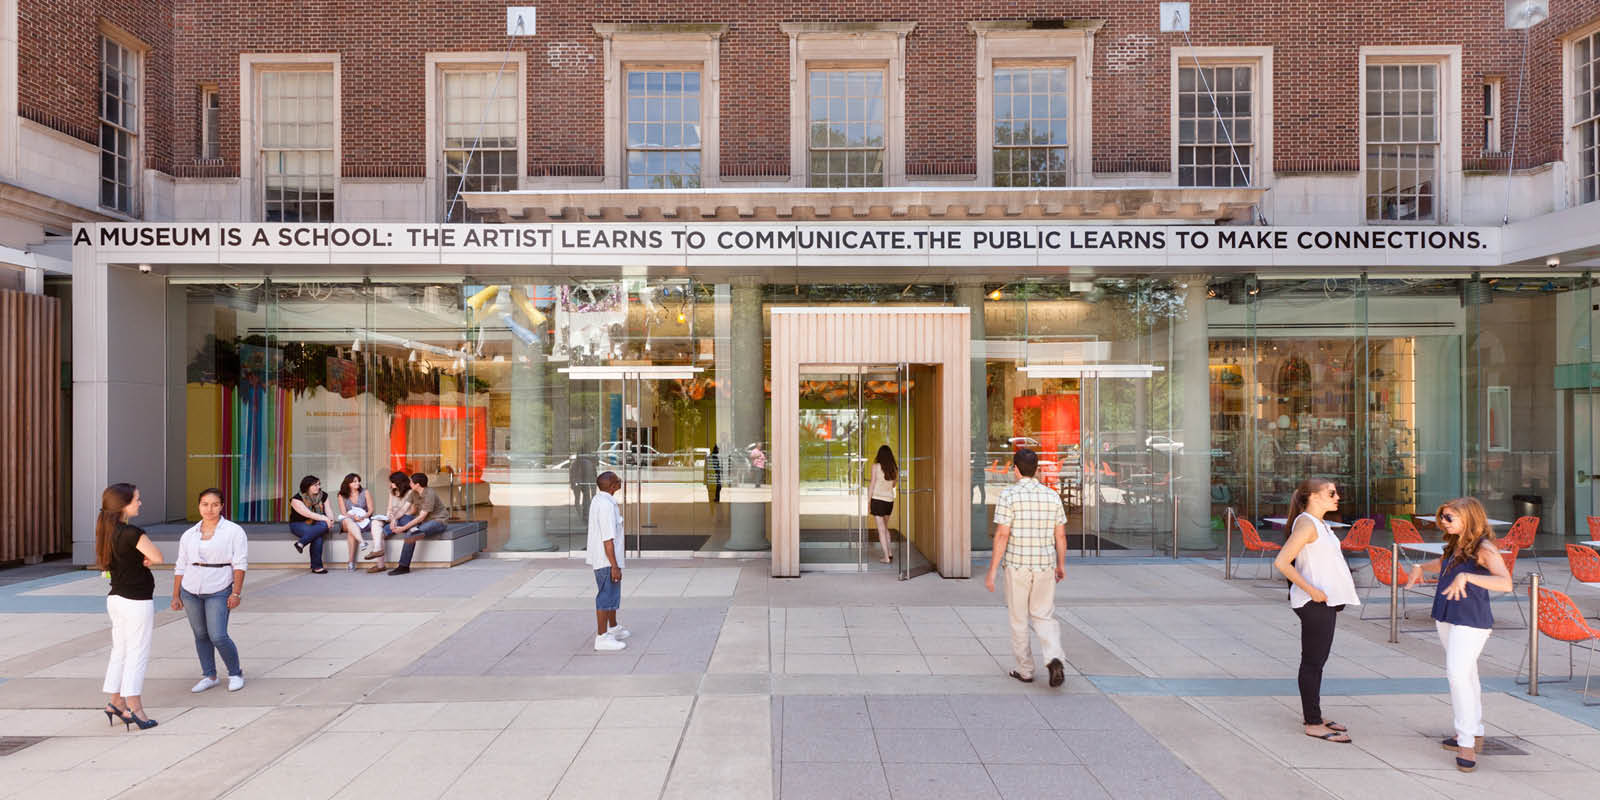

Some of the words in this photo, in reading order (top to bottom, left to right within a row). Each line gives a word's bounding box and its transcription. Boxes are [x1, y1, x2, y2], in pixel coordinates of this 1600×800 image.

[73, 228, 92, 246] A
[100, 227, 210, 246] MUSEUM
[220, 228, 242, 247] IS
[252, 228, 269, 246] A
[278, 228, 393, 247] SCHOOL:
[407, 229, 455, 247] THE
[464, 230, 551, 247] ARTIST
[561, 230, 662, 248] LEARNS
[672, 231, 705, 249] TO
[973, 231, 1061, 249] PUBLIC
[1070, 231, 1166, 249] LEARNS
[1176, 231, 1209, 249] TO
[1217, 231, 1288, 249] MAKE
[1297, 231, 1487, 249] CONNECTIONS.
